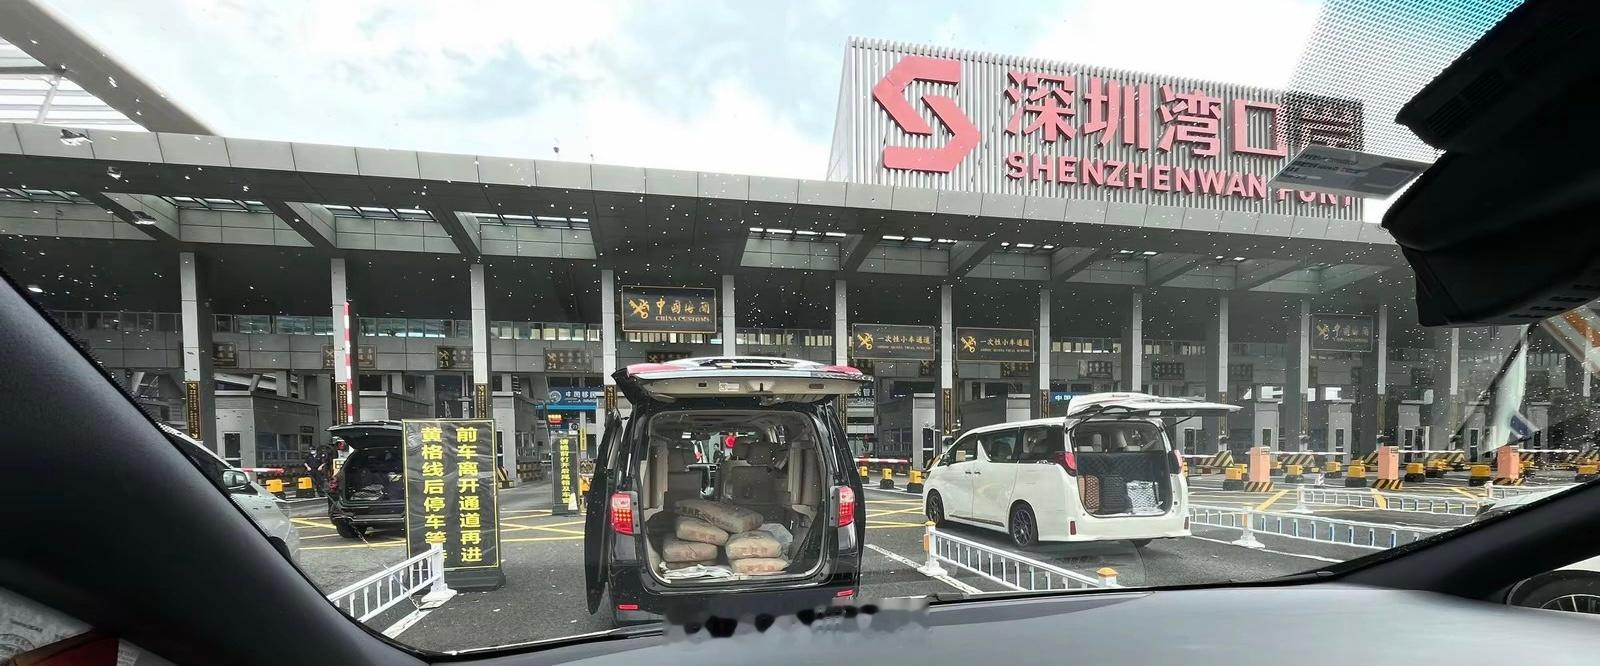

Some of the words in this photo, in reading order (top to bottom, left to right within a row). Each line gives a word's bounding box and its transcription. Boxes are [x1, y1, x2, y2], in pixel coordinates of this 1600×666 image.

[1006, 152, 1266, 199] SHENZHENWAN
[421, 427, 448, 559] 黄格线后停车等
[456, 427, 483, 563] 前车离开通道再进
